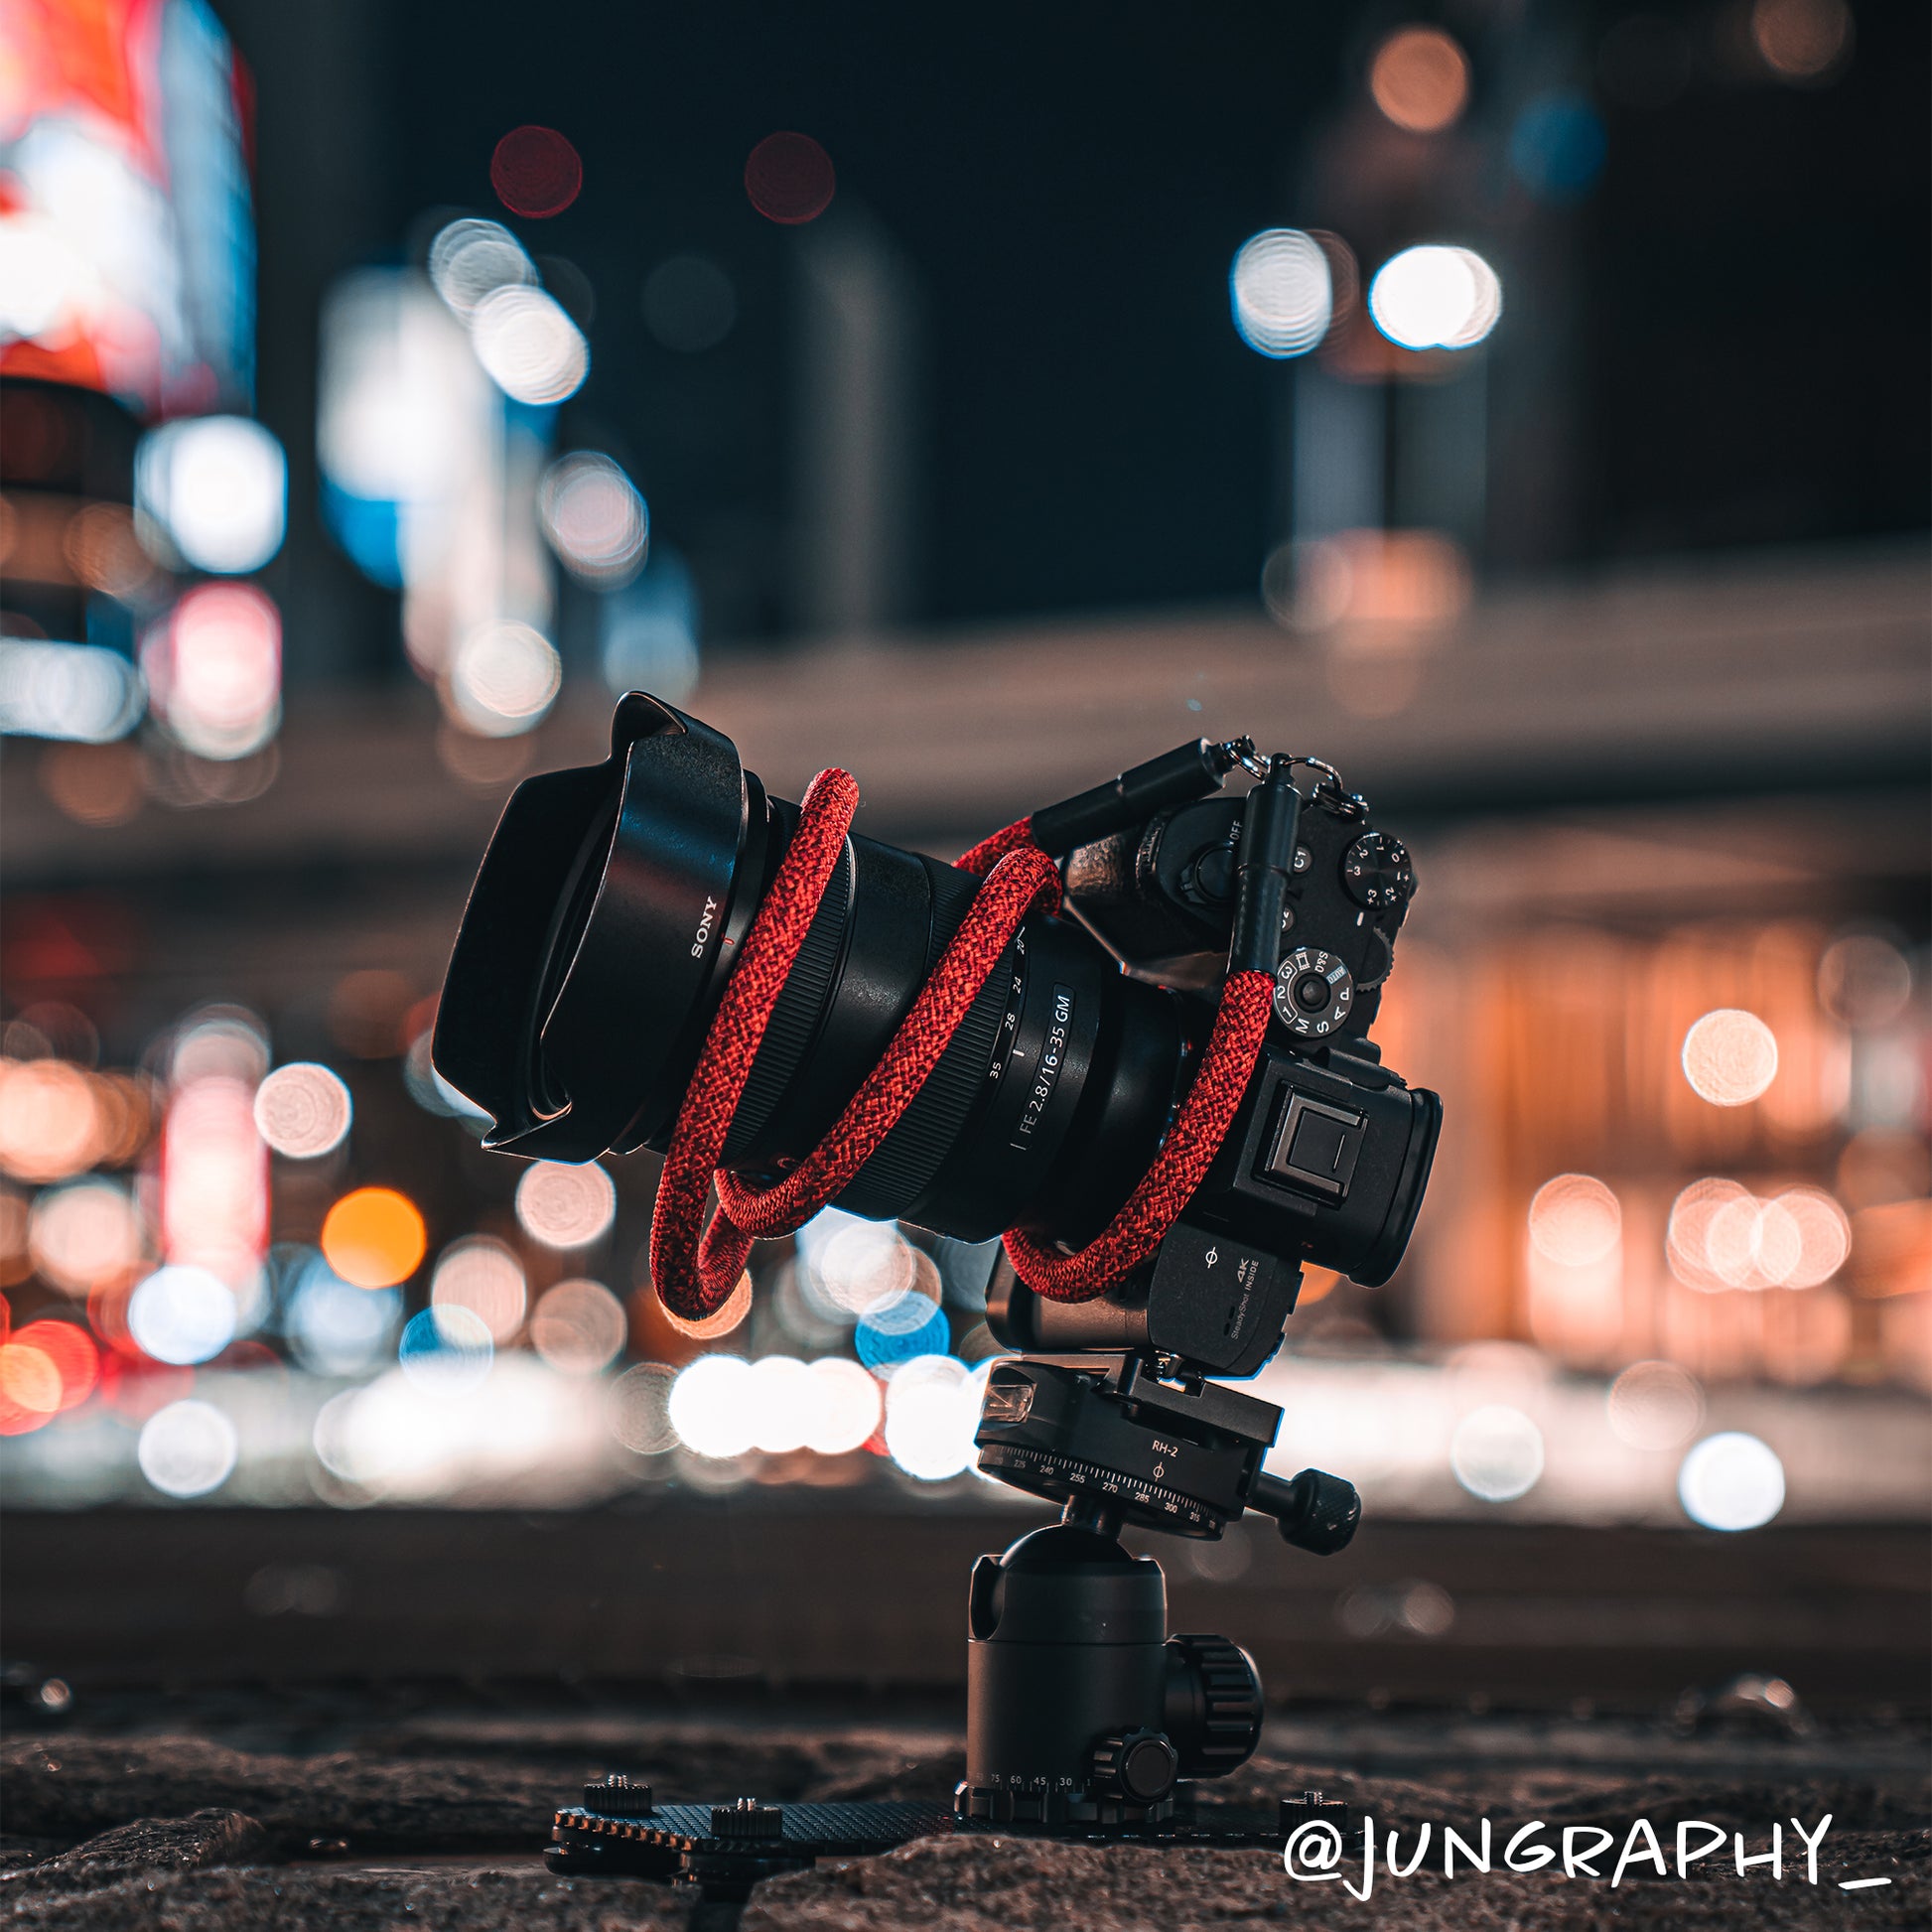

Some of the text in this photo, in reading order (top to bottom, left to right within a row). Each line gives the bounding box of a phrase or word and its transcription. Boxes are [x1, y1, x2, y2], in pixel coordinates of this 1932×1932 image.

[1229, 820, 1243, 840] OFF
[1294, 850, 1307, 869] C1
[690, 896, 717, 958] SONY
[1281, 966, 1293, 980] 3
[1013, 976, 1023, 995] 24
[1277, 985, 1286, 999] 2
[1339, 987, 1349, 1001] P
[1282, 1006, 1293, 1018] 1
[1333, 1006, 1346, 1021] A
[1005, 1012, 1016, 1032] 28
[1295, 1018, 1310, 1034] M
[1316, 1021, 1329, 1034] S
[990, 1061, 1002, 1079] 35
[1020, 995, 1070, 1134] FE 2.8/16-35 GM
[1237, 1257, 1250, 1284] 4K
[1231, 1260, 1260, 1340] SteadyShot INSIDE
[1152, 1440, 1178, 1457] RH-2
[1039, 1464, 1054, 1475] 240
[1069, 1472, 1086, 1484] 255
[1102, 1481, 1119, 1493] 270
[1134, 1491, 1151, 1504] 285
[1164, 1502, 1178, 1514] 300
[1189, 1511, 1200, 1523] 315
[1010, 1775, 1023, 1784] 60
[1034, 1776, 1046, 1786] 45
[1059, 1777, 1073, 1786] 30
